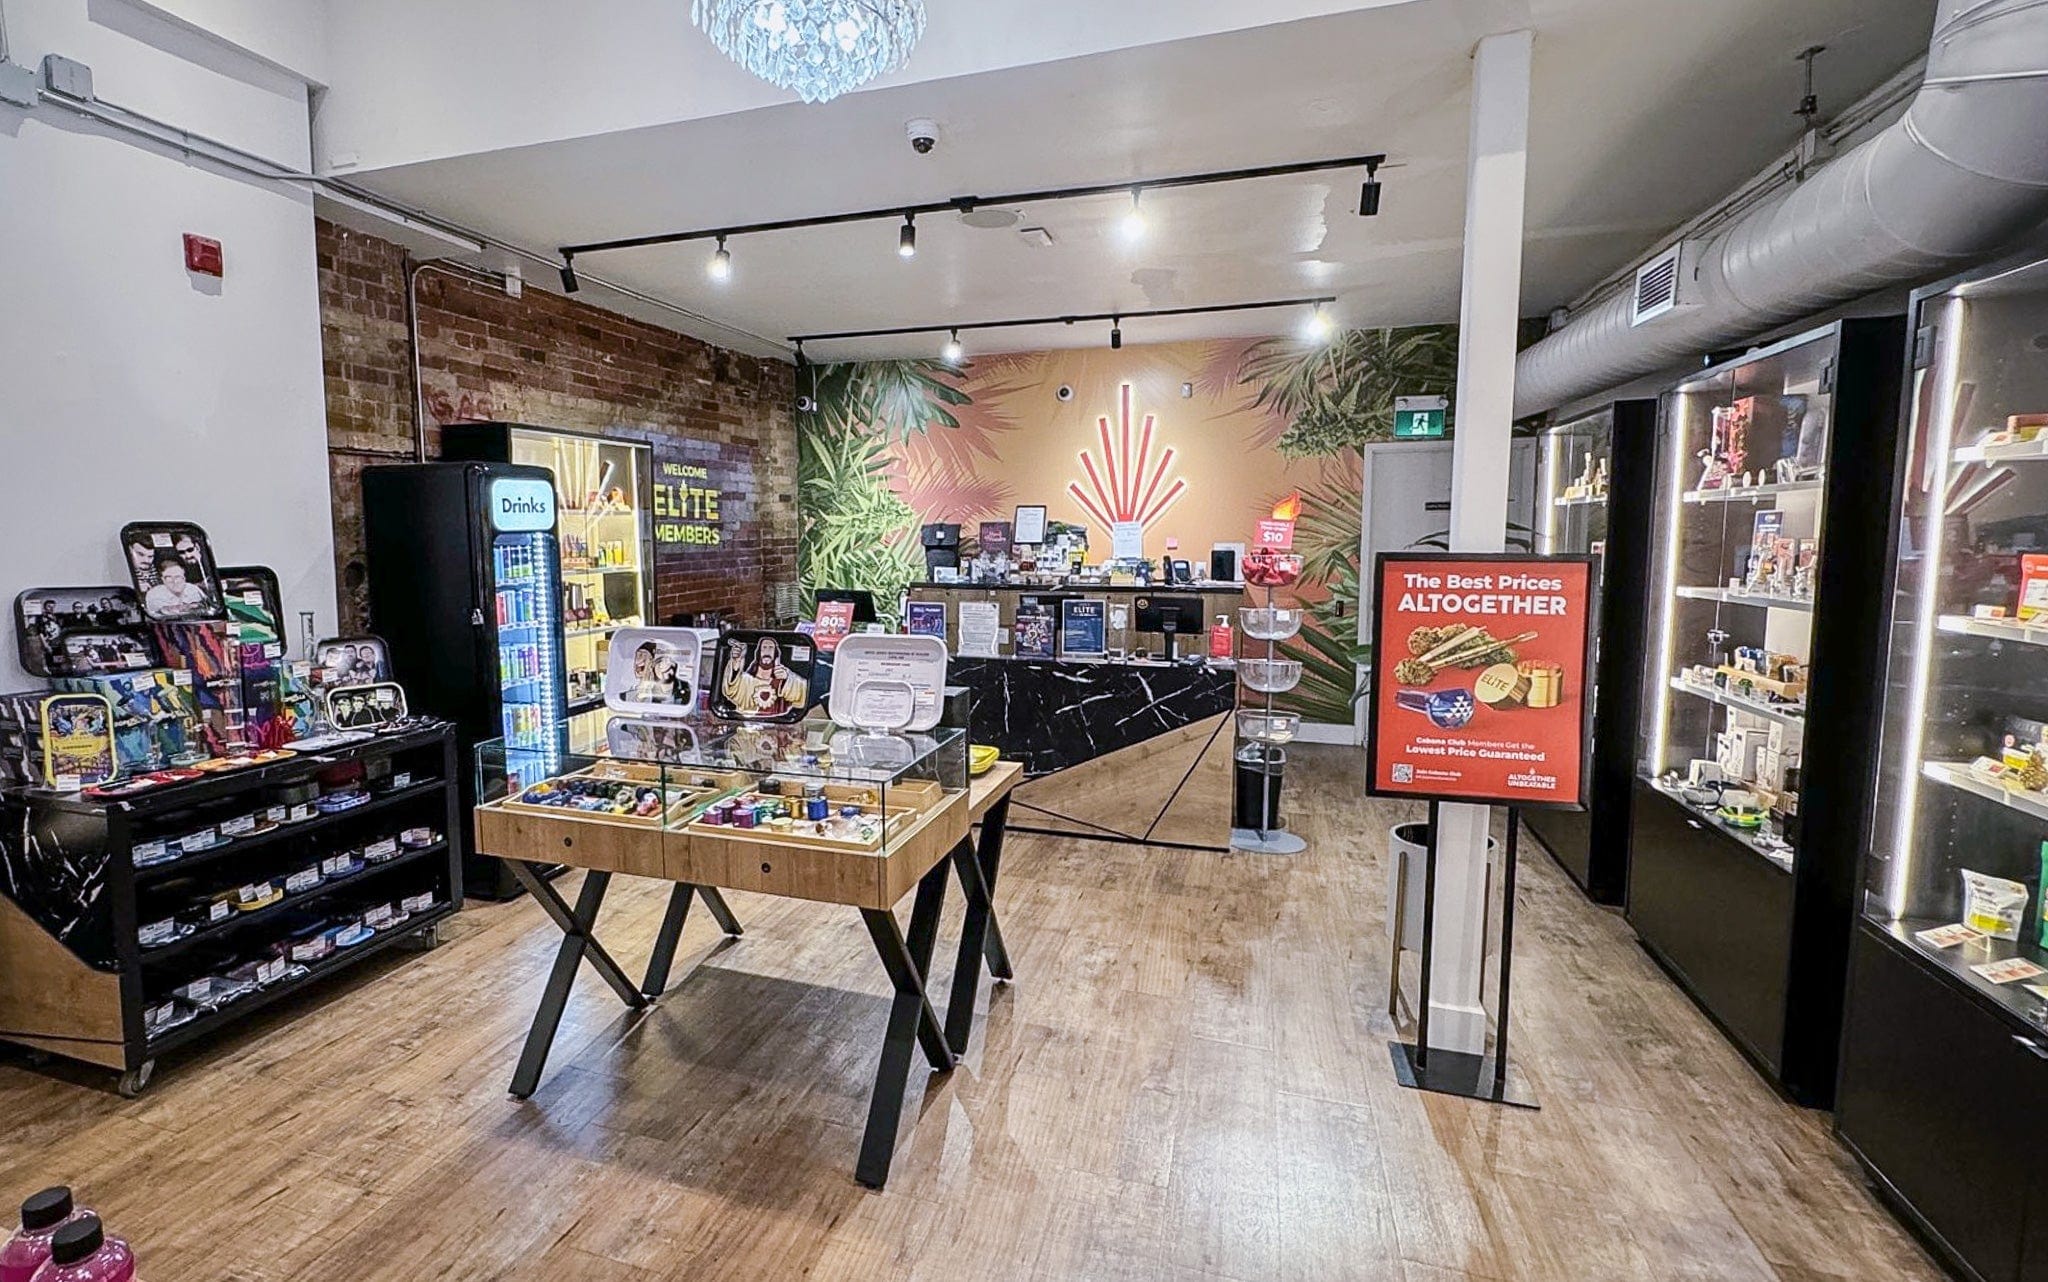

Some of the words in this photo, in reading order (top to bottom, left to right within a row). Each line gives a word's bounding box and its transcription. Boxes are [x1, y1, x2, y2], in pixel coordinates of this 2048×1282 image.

[663, 462, 708, 479] WELCOME
[501, 496, 547, 514] Drinks
[654, 480, 720, 520] ELITE
[655, 524, 721, 545] MEMBERS
[1262, 531, 1284, 543] $10
[1404, 574, 1441, 589] The
[1446, 575, 1493, 590] Best
[1498, 574, 1562, 591] Prices
[1073, 606, 1096, 614] ELITE
[1397, 594, 1567, 616] ALTOGETHER
[1480, 673, 1511, 693] ELITE
[1406, 744, 1446, 756] Lowest
[1447, 747, 1476, 758] Price
[1478, 749, 1546, 762] Guaranteed
[1447, 738, 1467, 747] Club
[1467, 739, 1504, 749] Members
[1505, 741, 1520, 749] Get
[1521, 742, 1536, 751] the
